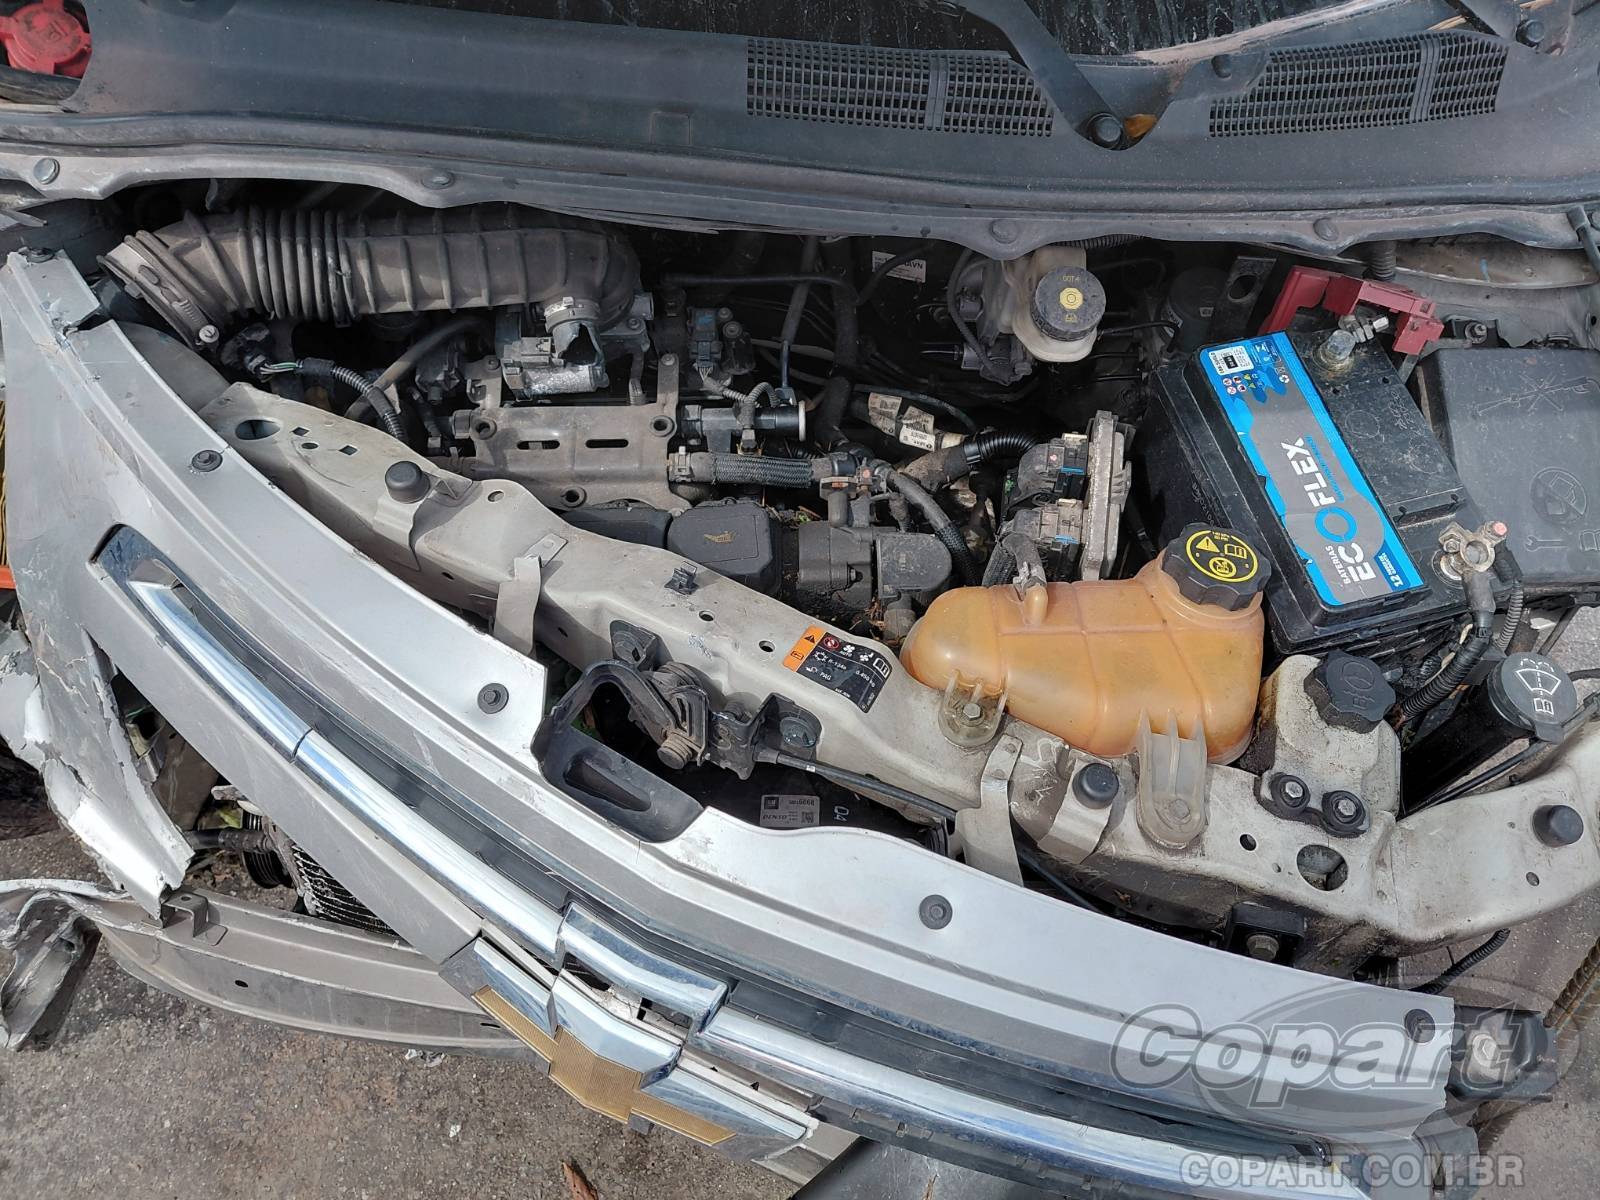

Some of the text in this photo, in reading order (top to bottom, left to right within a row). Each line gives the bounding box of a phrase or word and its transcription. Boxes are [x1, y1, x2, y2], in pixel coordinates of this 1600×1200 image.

[1325, 545, 1351, 585] BATERIAS
[1390, 574, 1404, 587] 12
[819, 671, 832, 681] PAG
